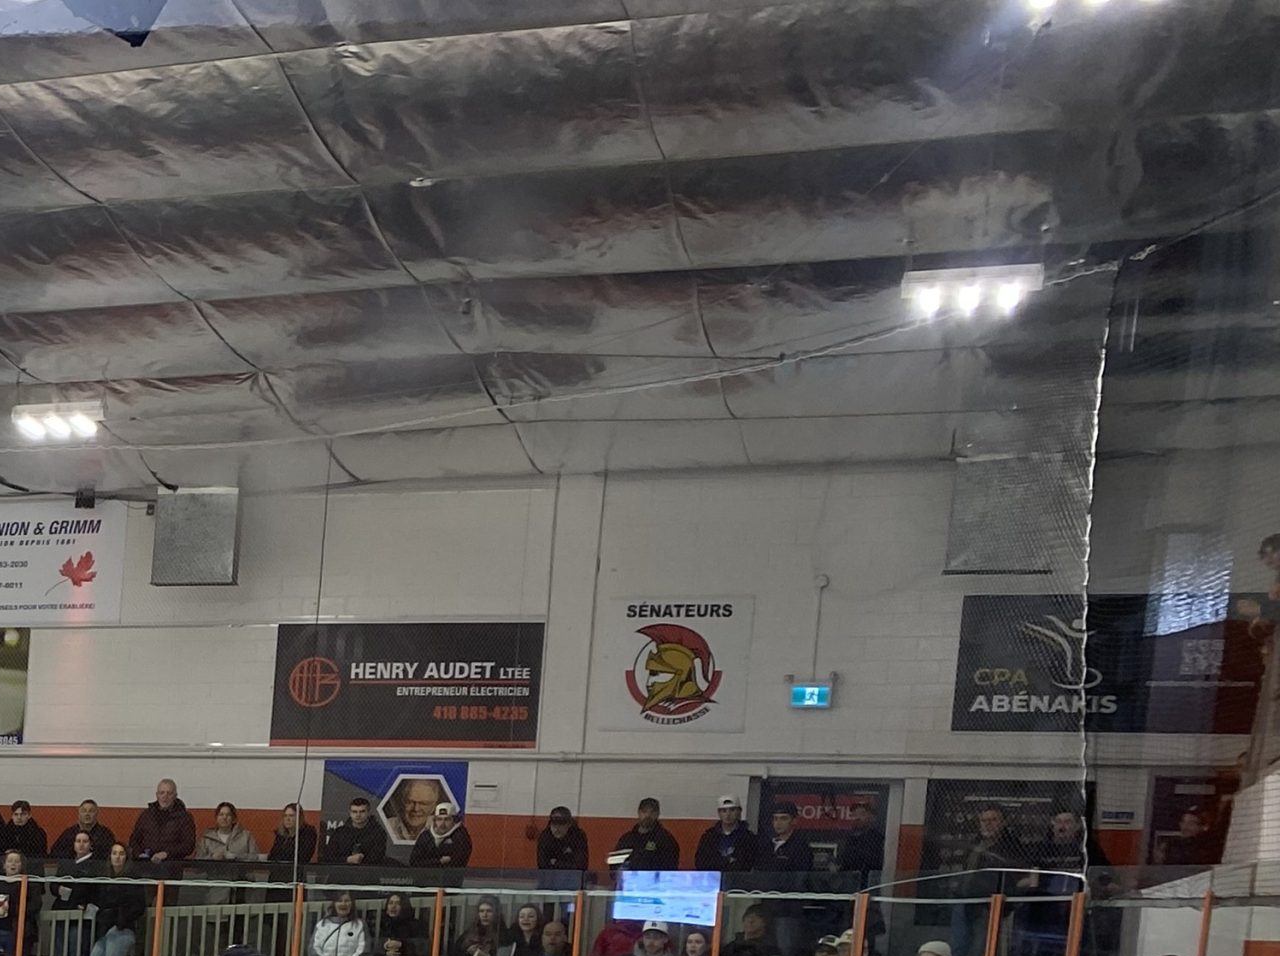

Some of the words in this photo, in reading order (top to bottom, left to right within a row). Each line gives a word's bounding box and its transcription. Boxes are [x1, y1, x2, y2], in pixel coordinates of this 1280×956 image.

[34, 519, 45, 535] &
[49, 519, 102, 535] GRIMM
[626, 601, 733, 618] SÉNATEURS
[350, 662, 419, 679] HENRY
[424, 662, 495, 679] AUDET
[974, 668, 1028, 685] CPA
[397, 687, 468, 696] ENTREPRENEUR
[470, 685, 530, 696] ÉLECTRICIEN
[970, 691, 1118, 714] ABÉNAKIS
[643, 706, 711, 725] BELLECHASSE
